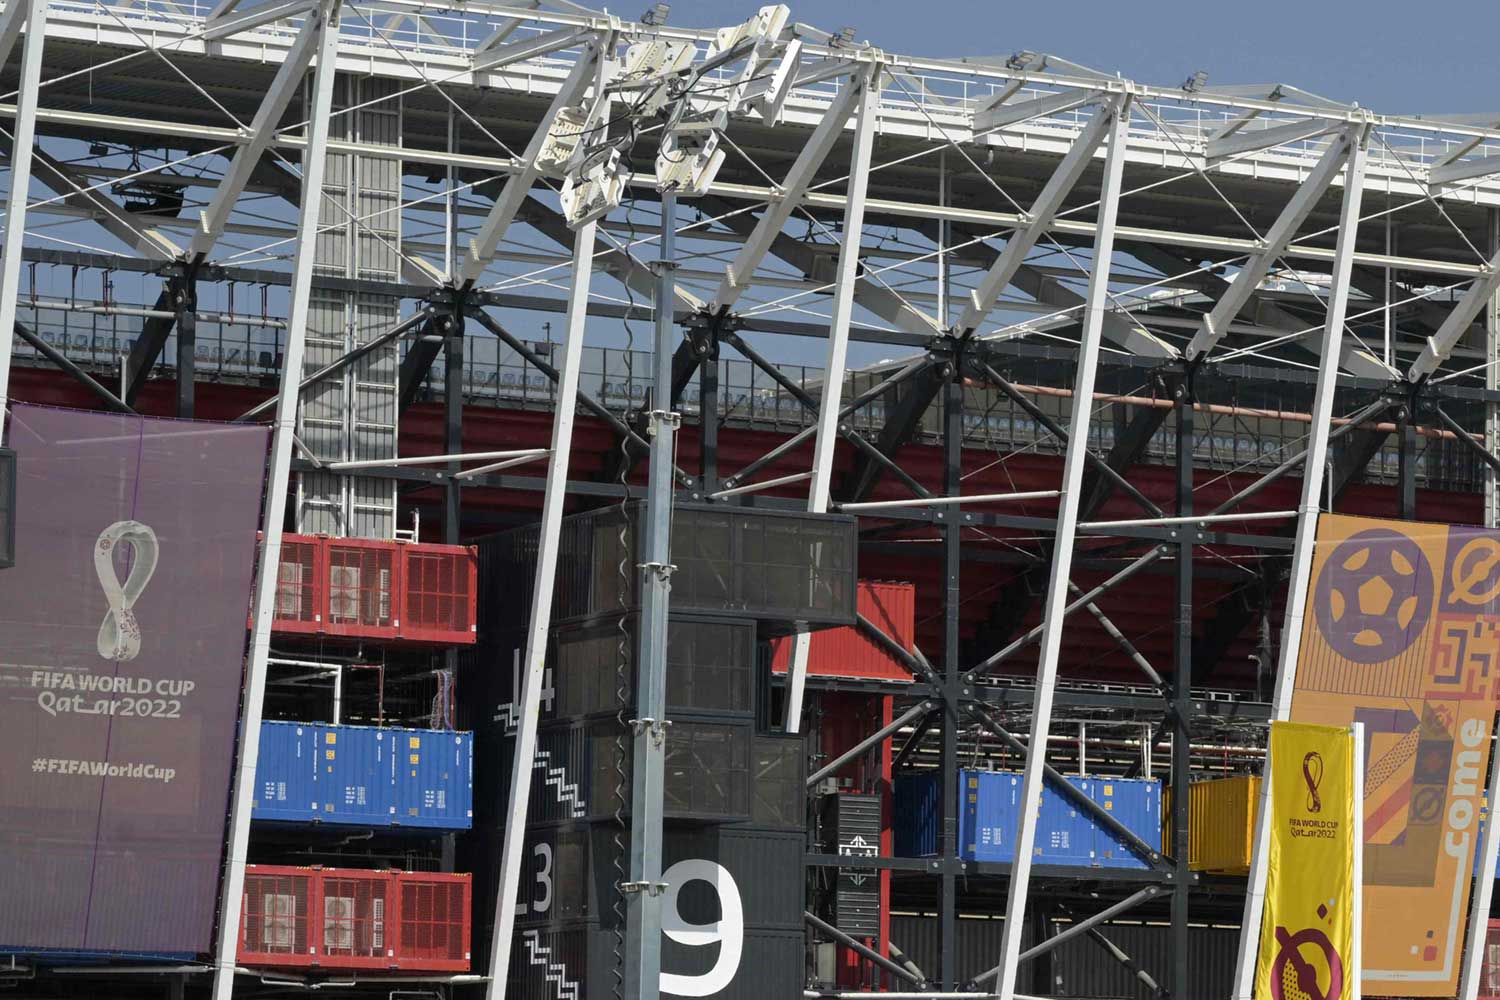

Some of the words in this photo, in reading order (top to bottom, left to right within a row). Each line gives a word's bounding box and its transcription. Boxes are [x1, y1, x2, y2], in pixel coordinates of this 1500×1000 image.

[31, 671, 76, 690] FIFA
[79, 675, 152, 694] WORLD
[156, 679, 195, 696] CUP
[38, 690, 181, 718] Qatar2022
[32, 758, 176, 783] #FIFAWorldCup
[1289, 818, 1301, 827] FIFA
[1302, 819, 1326, 829] WORLD
[1326, 821, 1339, 829] CUP
[659, 858, 744, 997] 9
